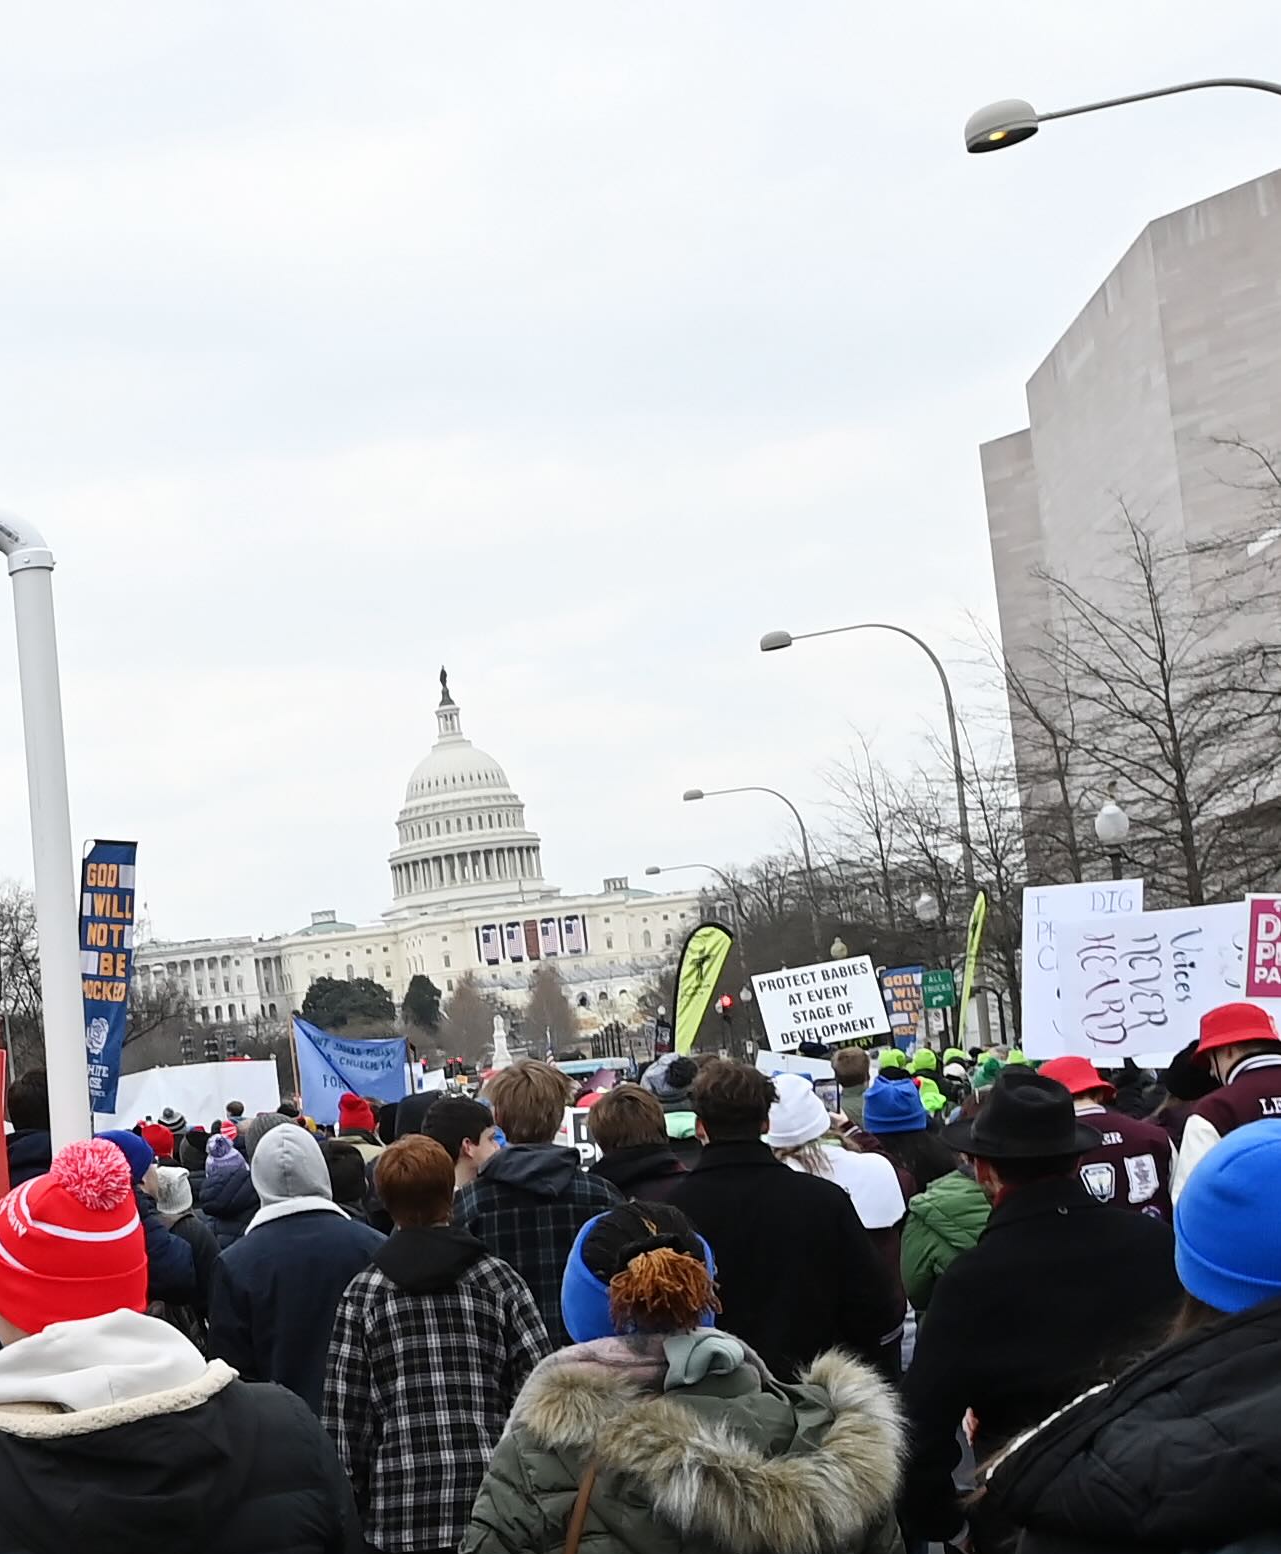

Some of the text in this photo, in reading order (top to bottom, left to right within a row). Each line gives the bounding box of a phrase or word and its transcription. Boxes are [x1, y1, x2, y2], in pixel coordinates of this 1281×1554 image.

[93, 892, 133, 919] WILL
[1090, 890, 1134, 913] DIG
[86, 921, 124, 948] NOT
[99, 952, 127, 978] BE
[758, 961, 869, 993] PROTECT BABIES
[1170, 926, 1204, 1003] Voices
[928, 974, 942, 983] ALL
[788, 983, 850, 1006] AT EVERY
[792, 1001, 854, 1024] STAGE OF
[780, 1016, 877, 1045] DEVELOPMENT
